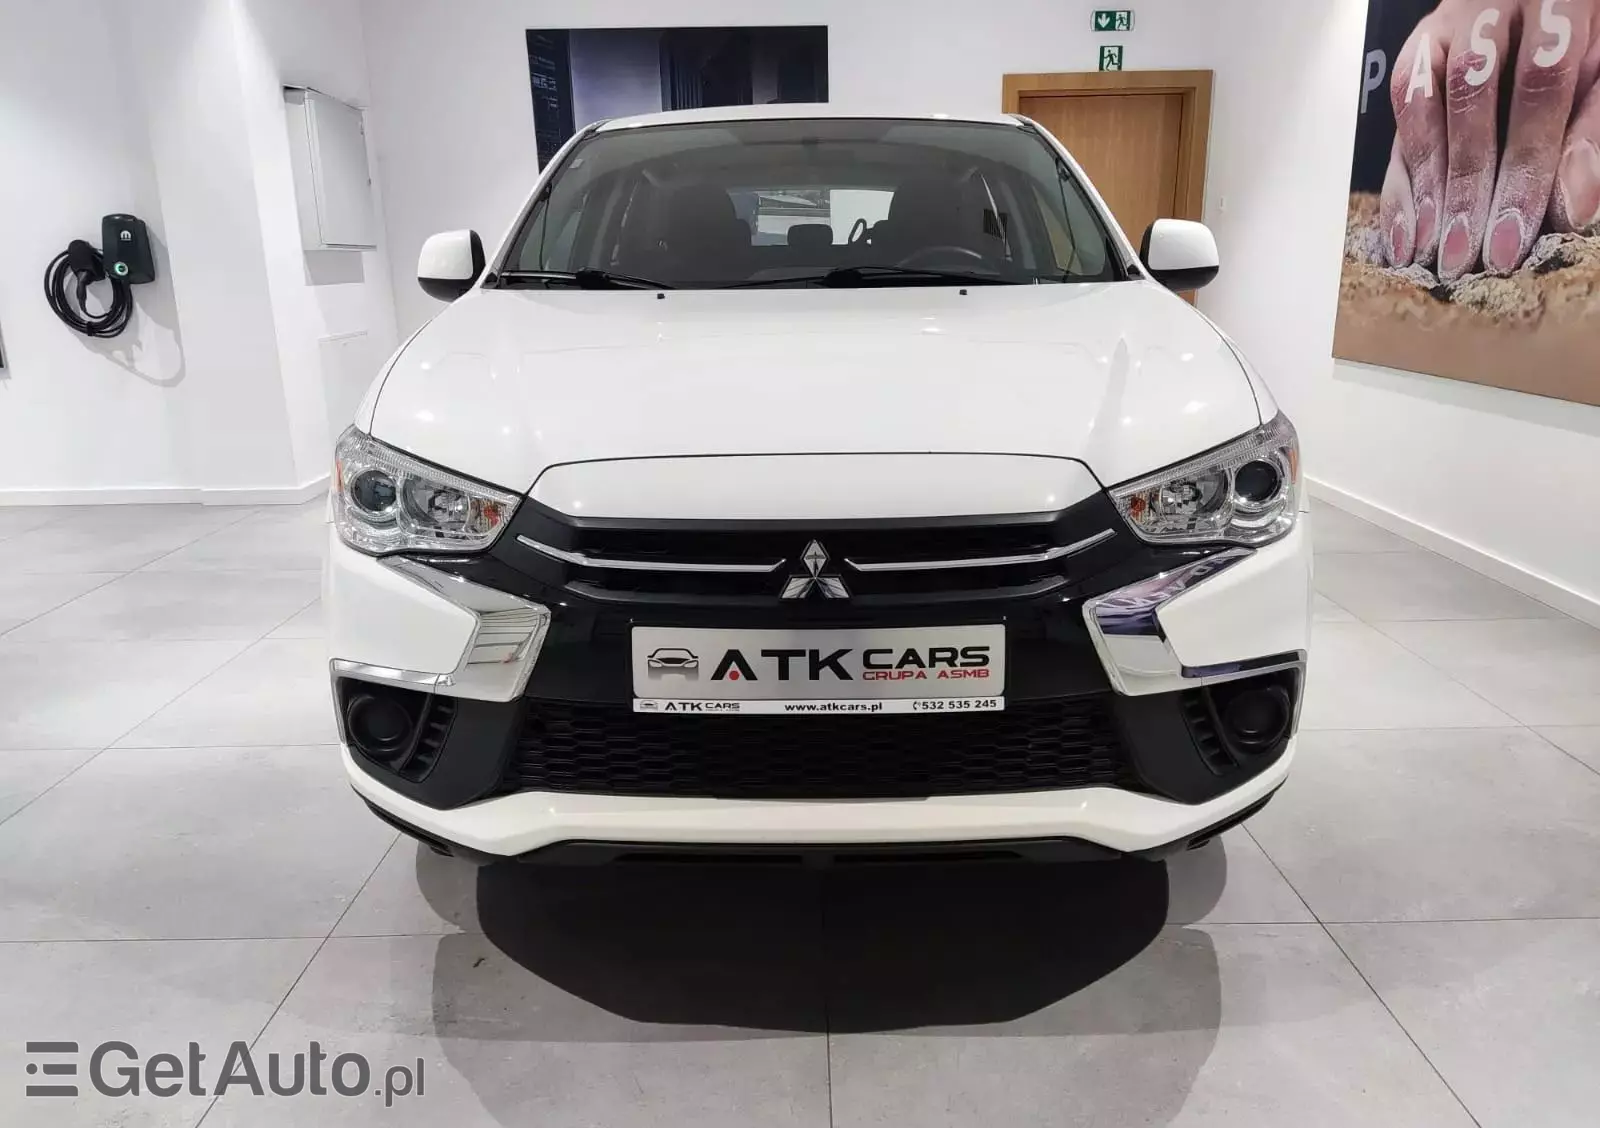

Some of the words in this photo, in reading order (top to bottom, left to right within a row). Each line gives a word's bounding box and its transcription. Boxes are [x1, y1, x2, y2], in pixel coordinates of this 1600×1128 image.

[710, 649, 854, 681] ATK
[863, 646, 990, 669] CARS
[863, 670, 927, 681] GRUPA
[937, 668, 990, 679] ASMB
[664, 702, 703, 711] ATK
[785, 702, 882, 712] www.atkcars.pl
[922, 701, 944, 710] 532
[950, 700, 970, 709] 535
[975, 699, 997, 708] 245
